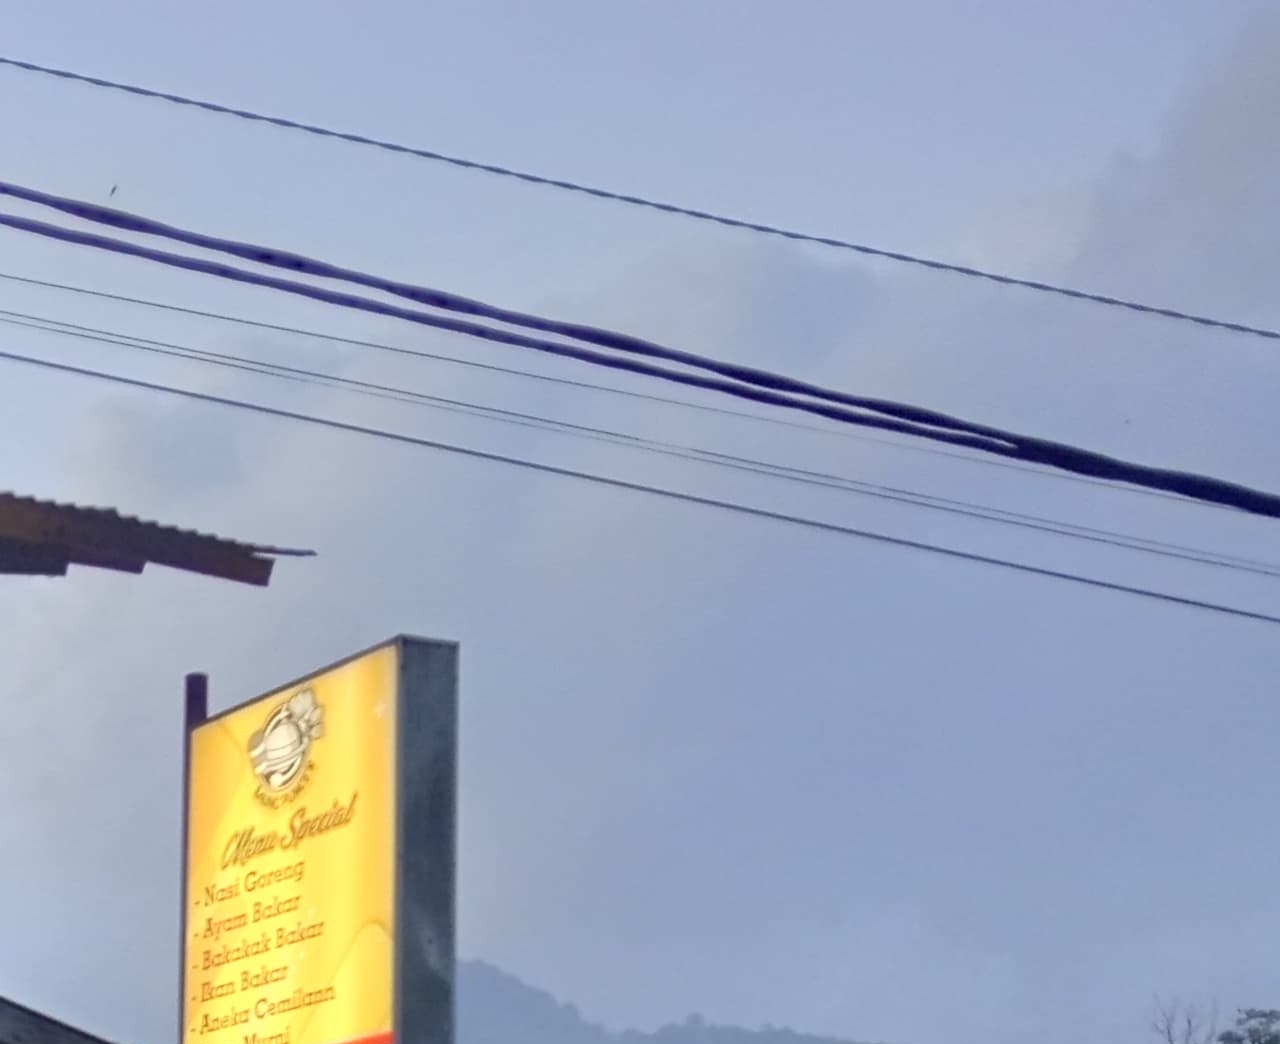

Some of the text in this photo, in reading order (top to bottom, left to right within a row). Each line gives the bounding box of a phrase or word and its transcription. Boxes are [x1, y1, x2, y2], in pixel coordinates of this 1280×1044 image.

[221, 790, 358, 870] Menu Special
[204, 861, 305, 906] Nasi Goreng
[202, 895, 301, 940] Ayam Bakar
[202, 921, 324, 970] Bakakak Bakar
[240, 966, 288, 991] Bakar
